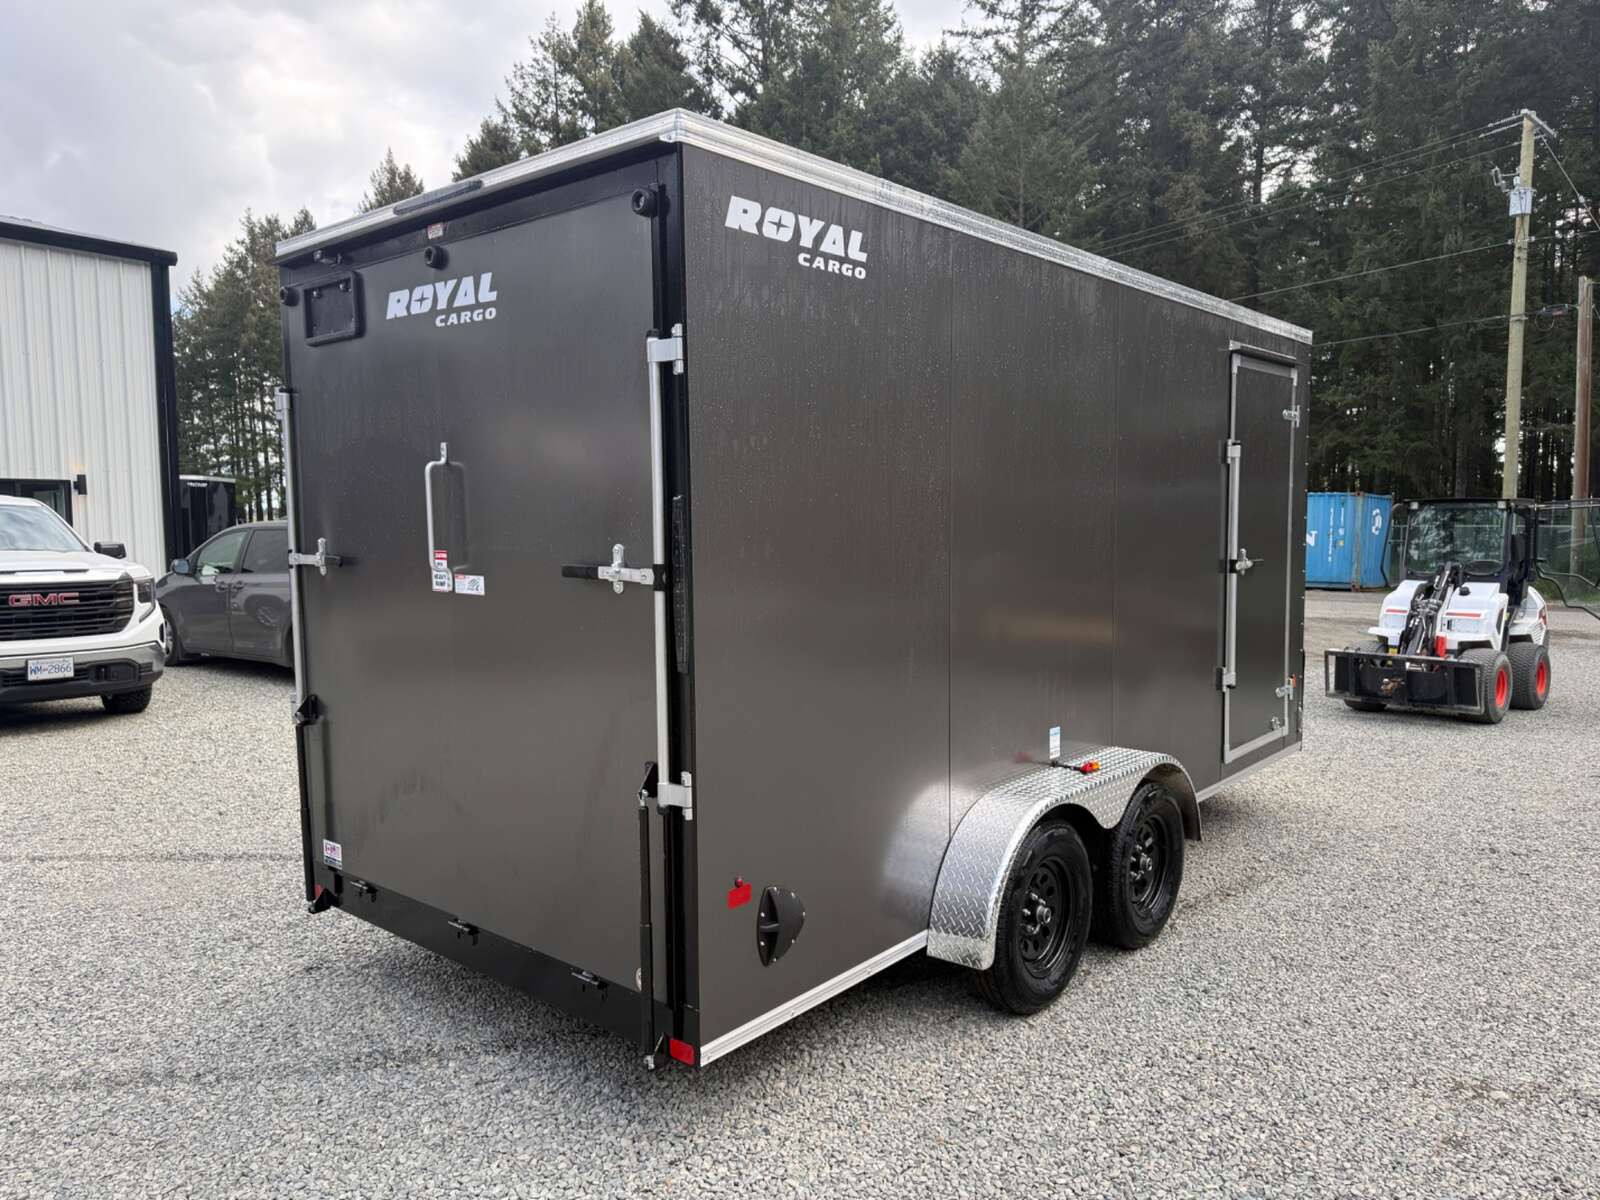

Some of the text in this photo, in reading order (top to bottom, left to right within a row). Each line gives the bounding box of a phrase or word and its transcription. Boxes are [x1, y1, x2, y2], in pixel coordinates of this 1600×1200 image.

[725, 195, 868, 263] ROYAL
[798, 252, 867, 280] CARGO
[386, 272, 498, 320] ROYAL
[435, 307, 497, 327] CARGO
[8, 592, 80, 607] GMC
